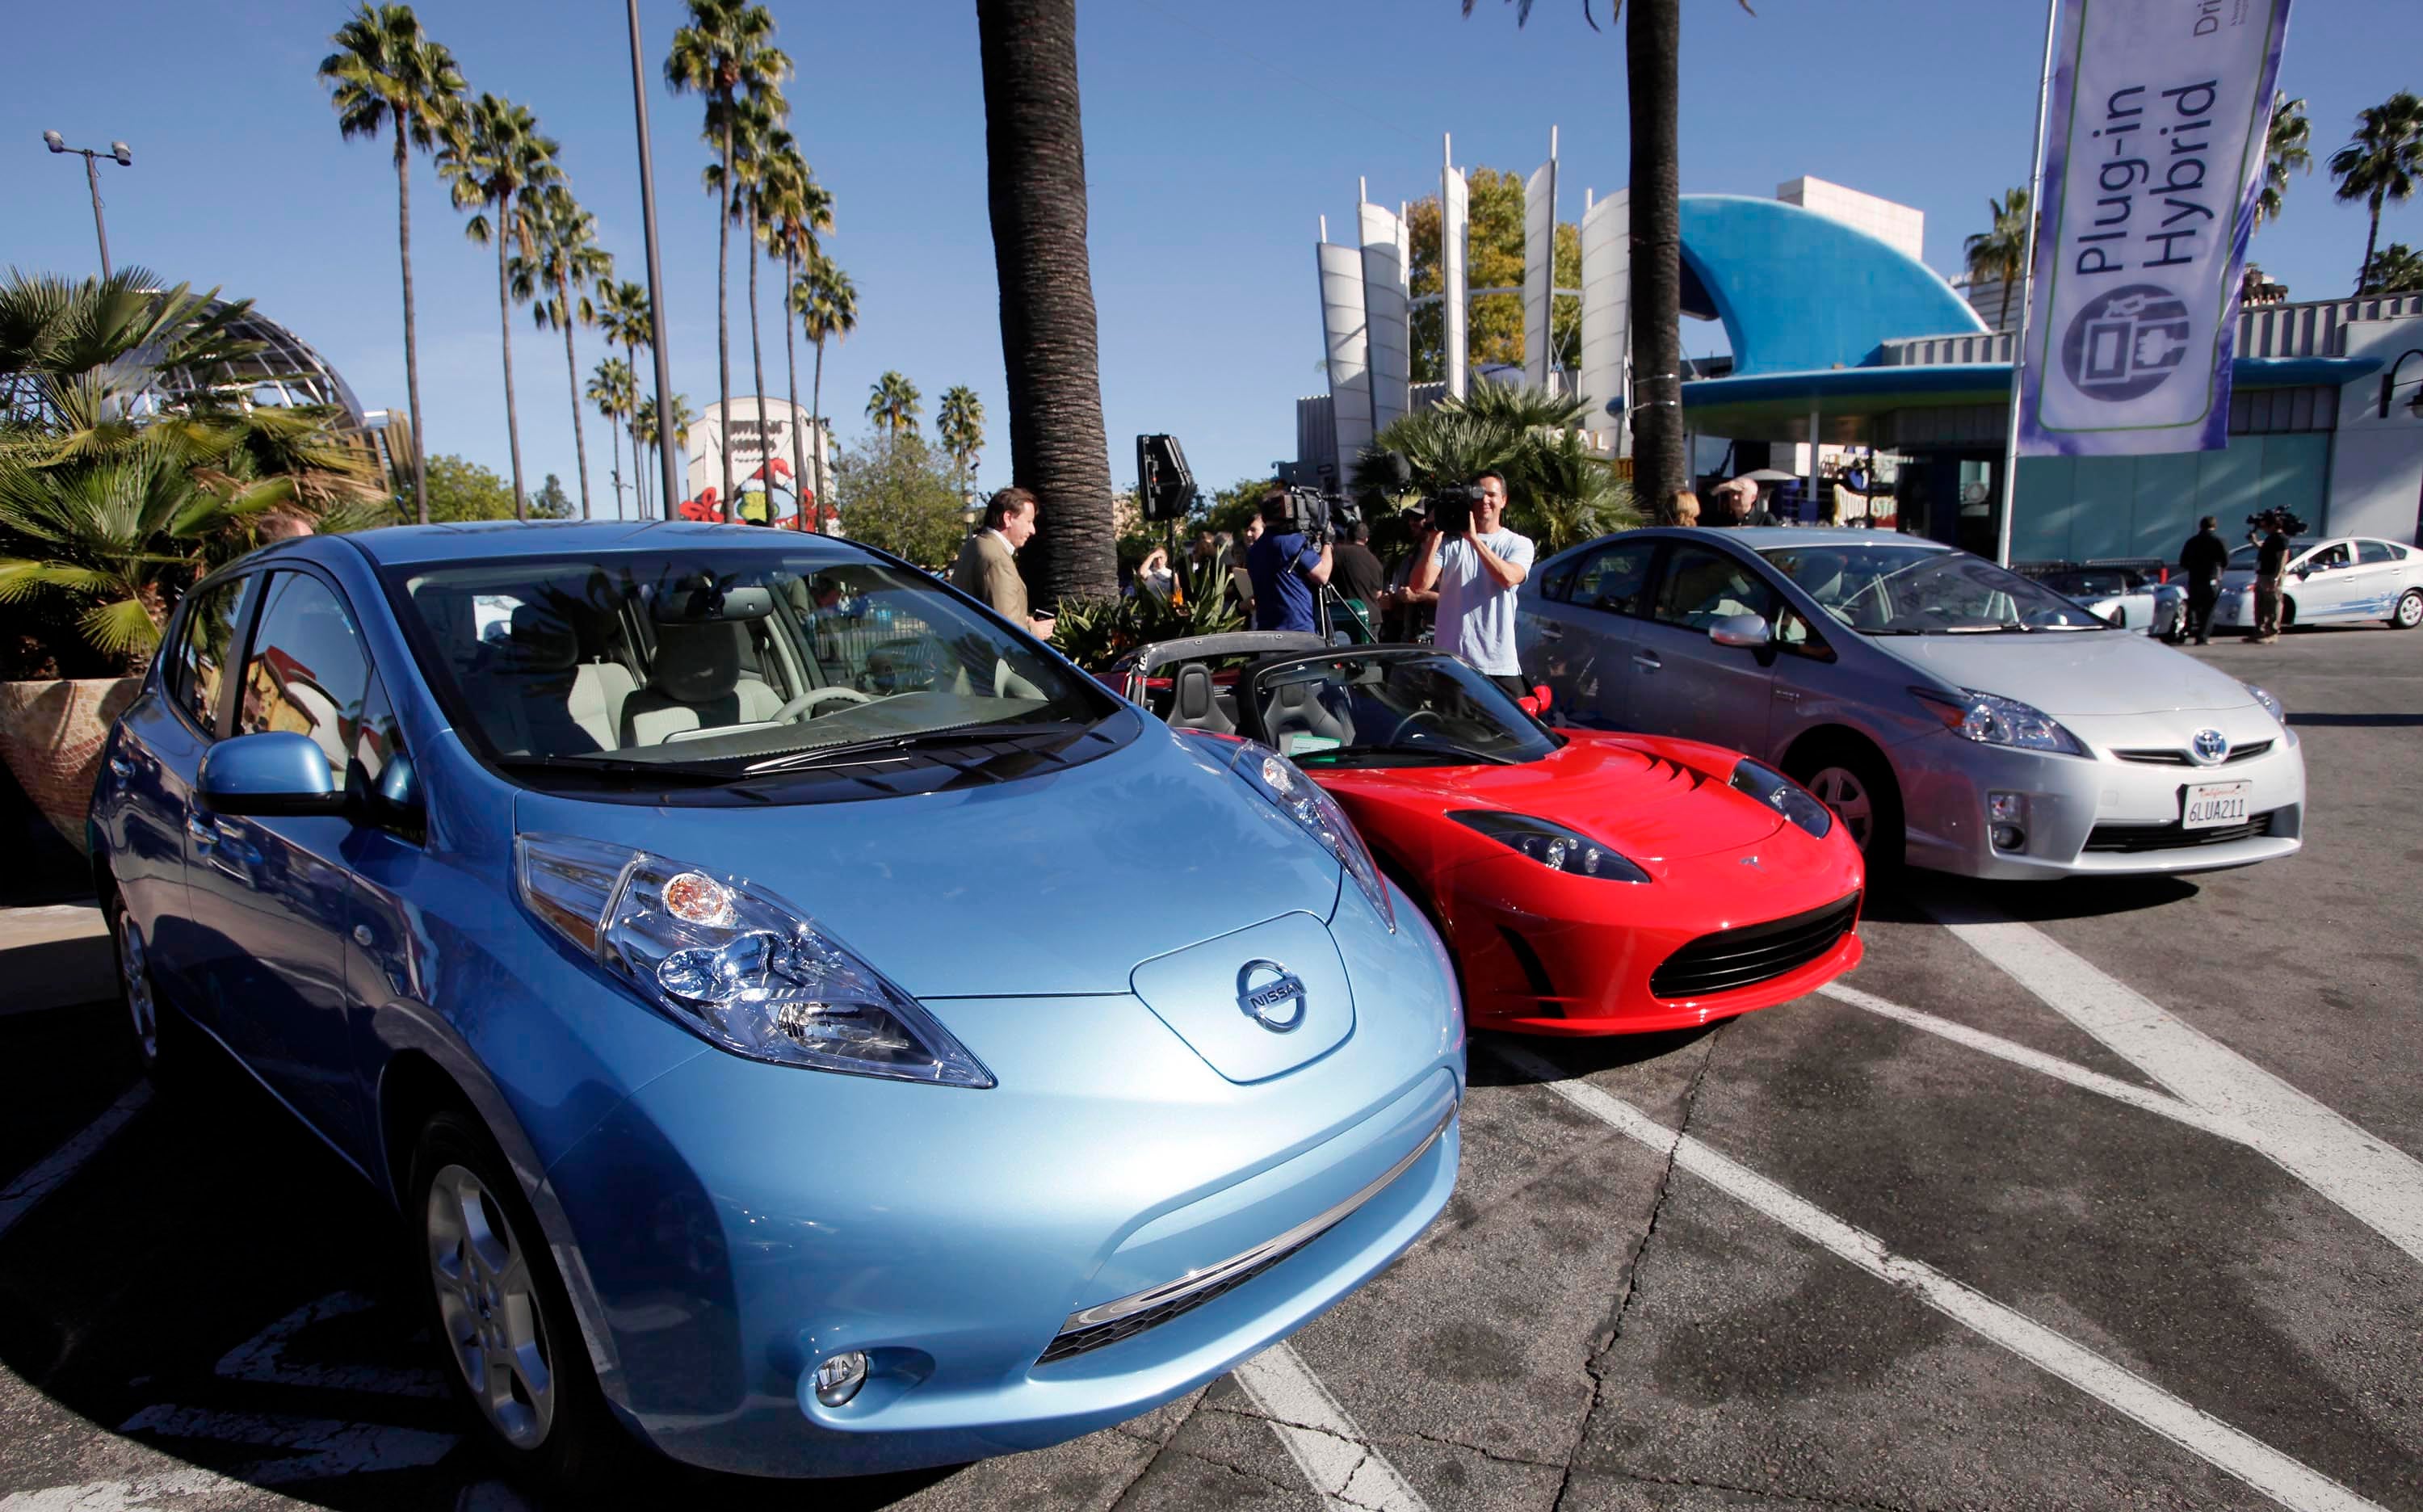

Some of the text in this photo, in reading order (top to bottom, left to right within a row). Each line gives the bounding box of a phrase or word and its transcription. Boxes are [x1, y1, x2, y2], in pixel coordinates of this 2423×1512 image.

[2077, 86, 2149, 275] Plug-in
[2143, 80, 2217, 268] Hybrid
[2189, 799, 2244, 821] 6LUA211
[1250, 981, 1304, 1009] NISSAN
